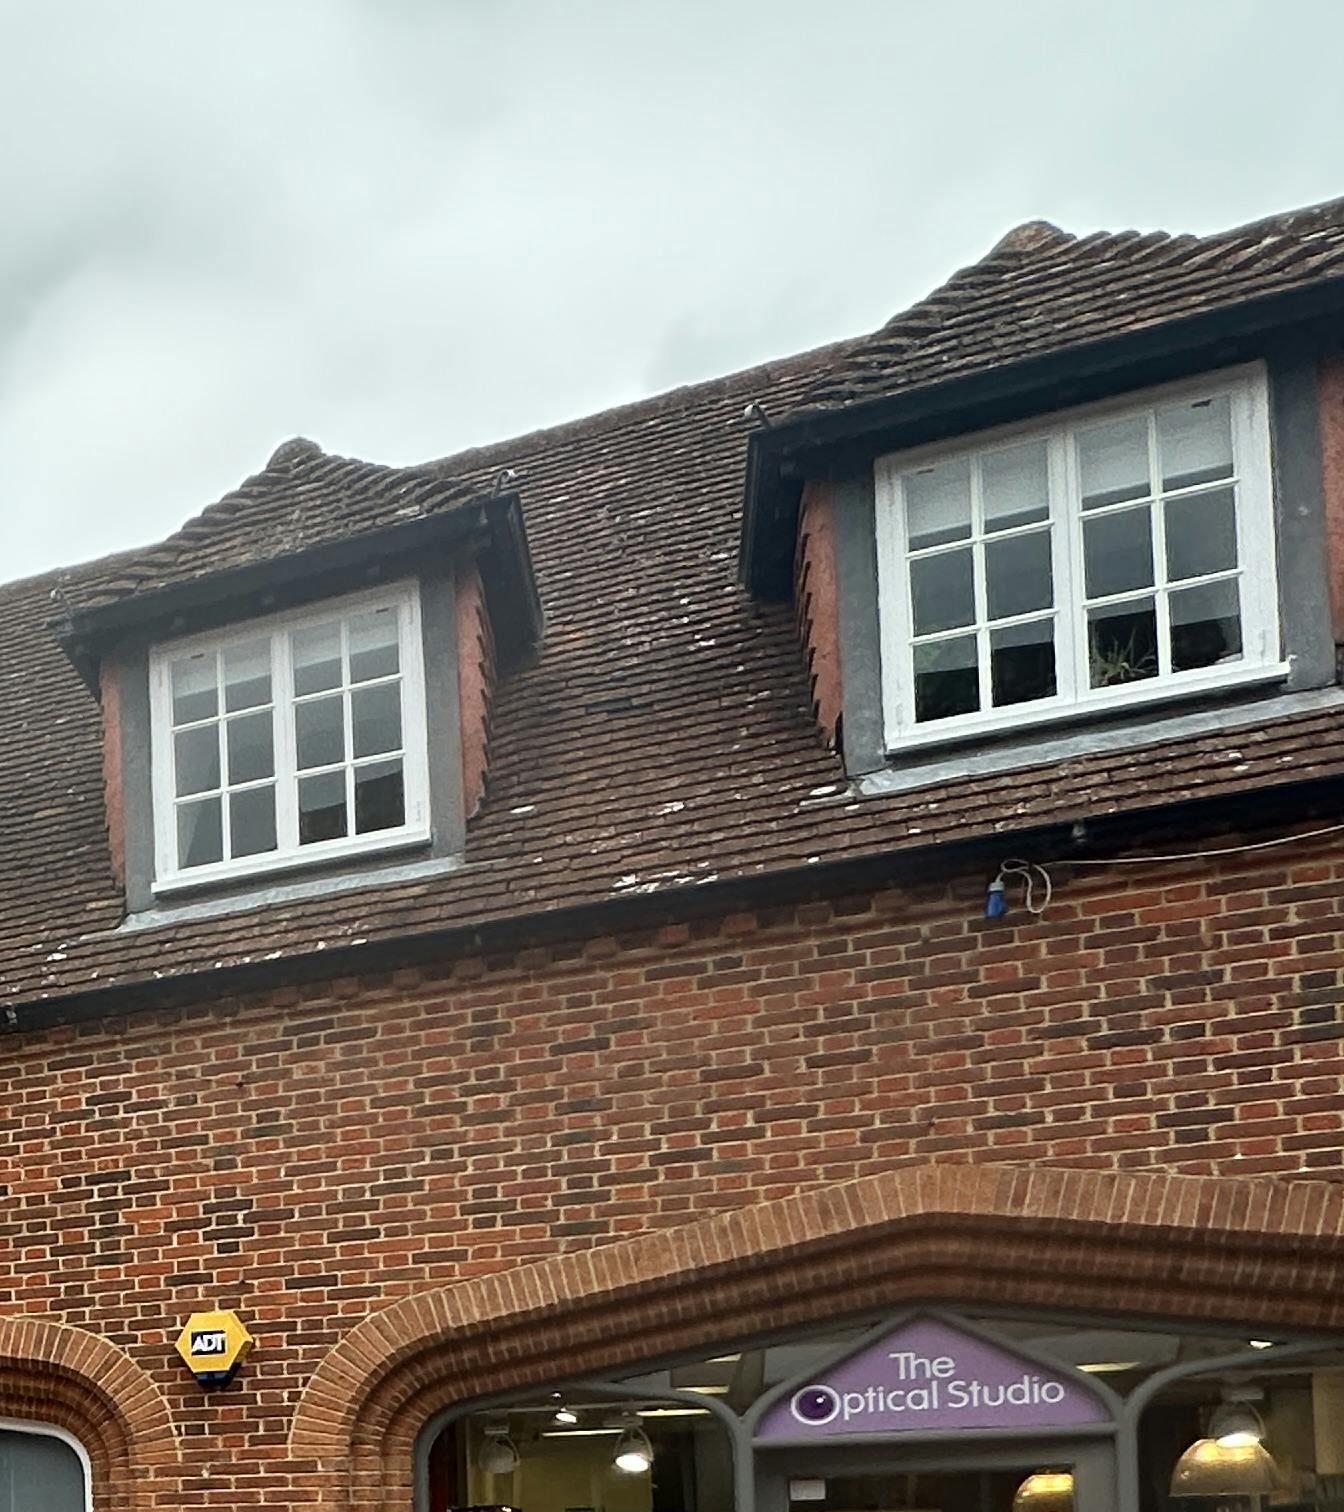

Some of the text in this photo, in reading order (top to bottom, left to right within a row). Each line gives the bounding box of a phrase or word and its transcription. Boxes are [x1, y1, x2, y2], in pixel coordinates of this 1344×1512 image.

[191, 1333, 227, 1352] ADT
[889, 1352, 955, 1380] The
[791, 1375, 1065, 1426] Optical Studio
